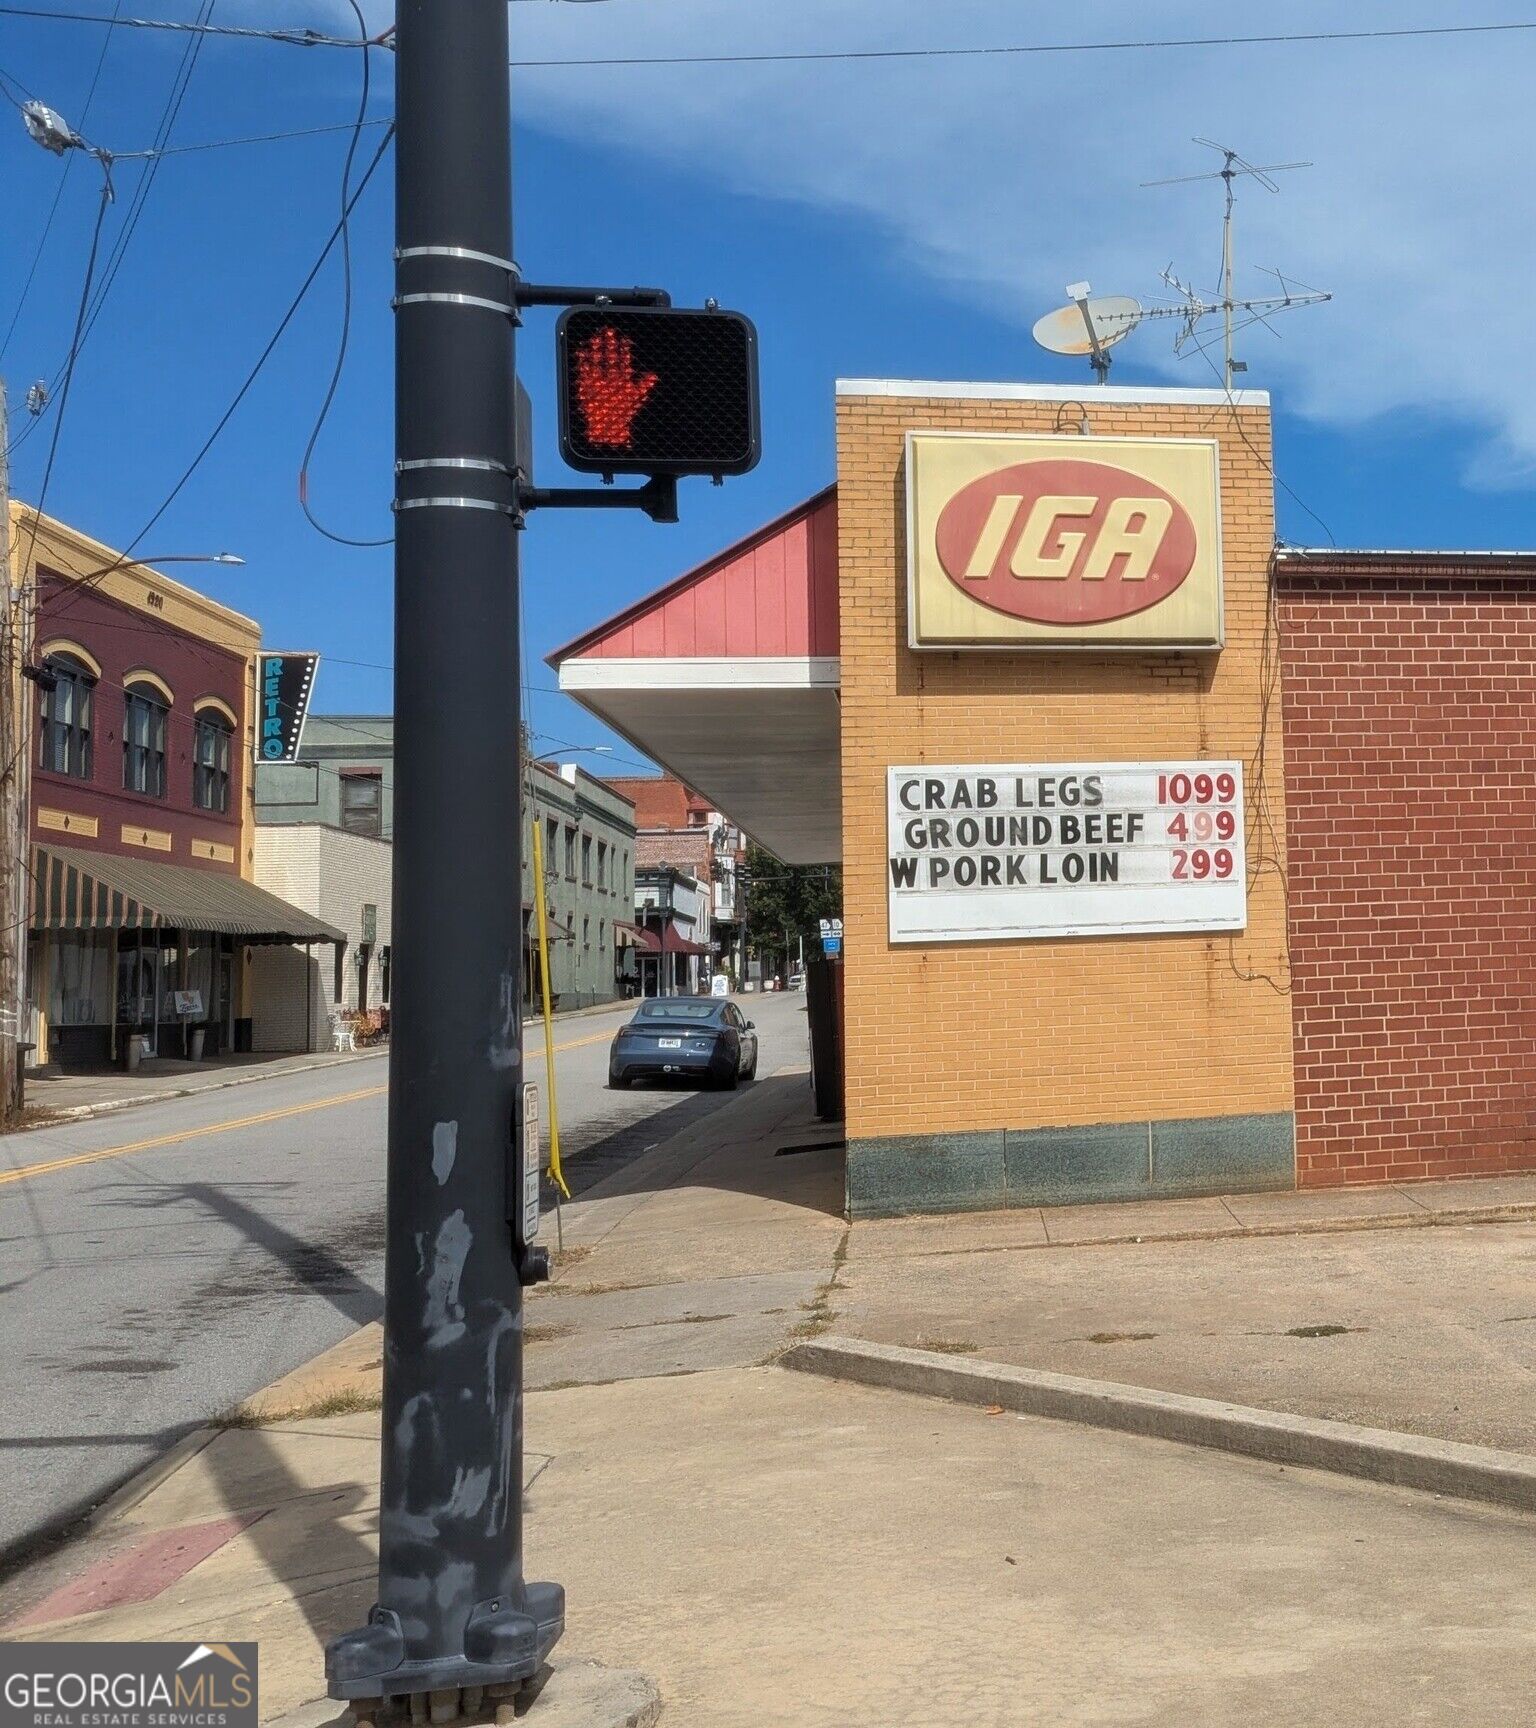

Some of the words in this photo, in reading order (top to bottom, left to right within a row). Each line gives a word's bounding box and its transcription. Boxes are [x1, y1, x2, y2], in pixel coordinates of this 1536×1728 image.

[963, 494, 1174, 582] IGA
[264, 658, 283, 760] RETRO
[899, 777, 999, 811] CRAB
[1016, 775, 1103, 808] LEGS
[1158, 773, 1236, 806] 1099
[905, 815, 1052, 850] GROUND
[1060, 813, 1144, 845] BEEF
[1167, 810, 1235, 843] 499
[890, 857, 918, 888] W
[930, 855, 1027, 888] PORK
[1039, 851, 1119, 884] LOIN
[1172, 848, 1234, 880] 299
